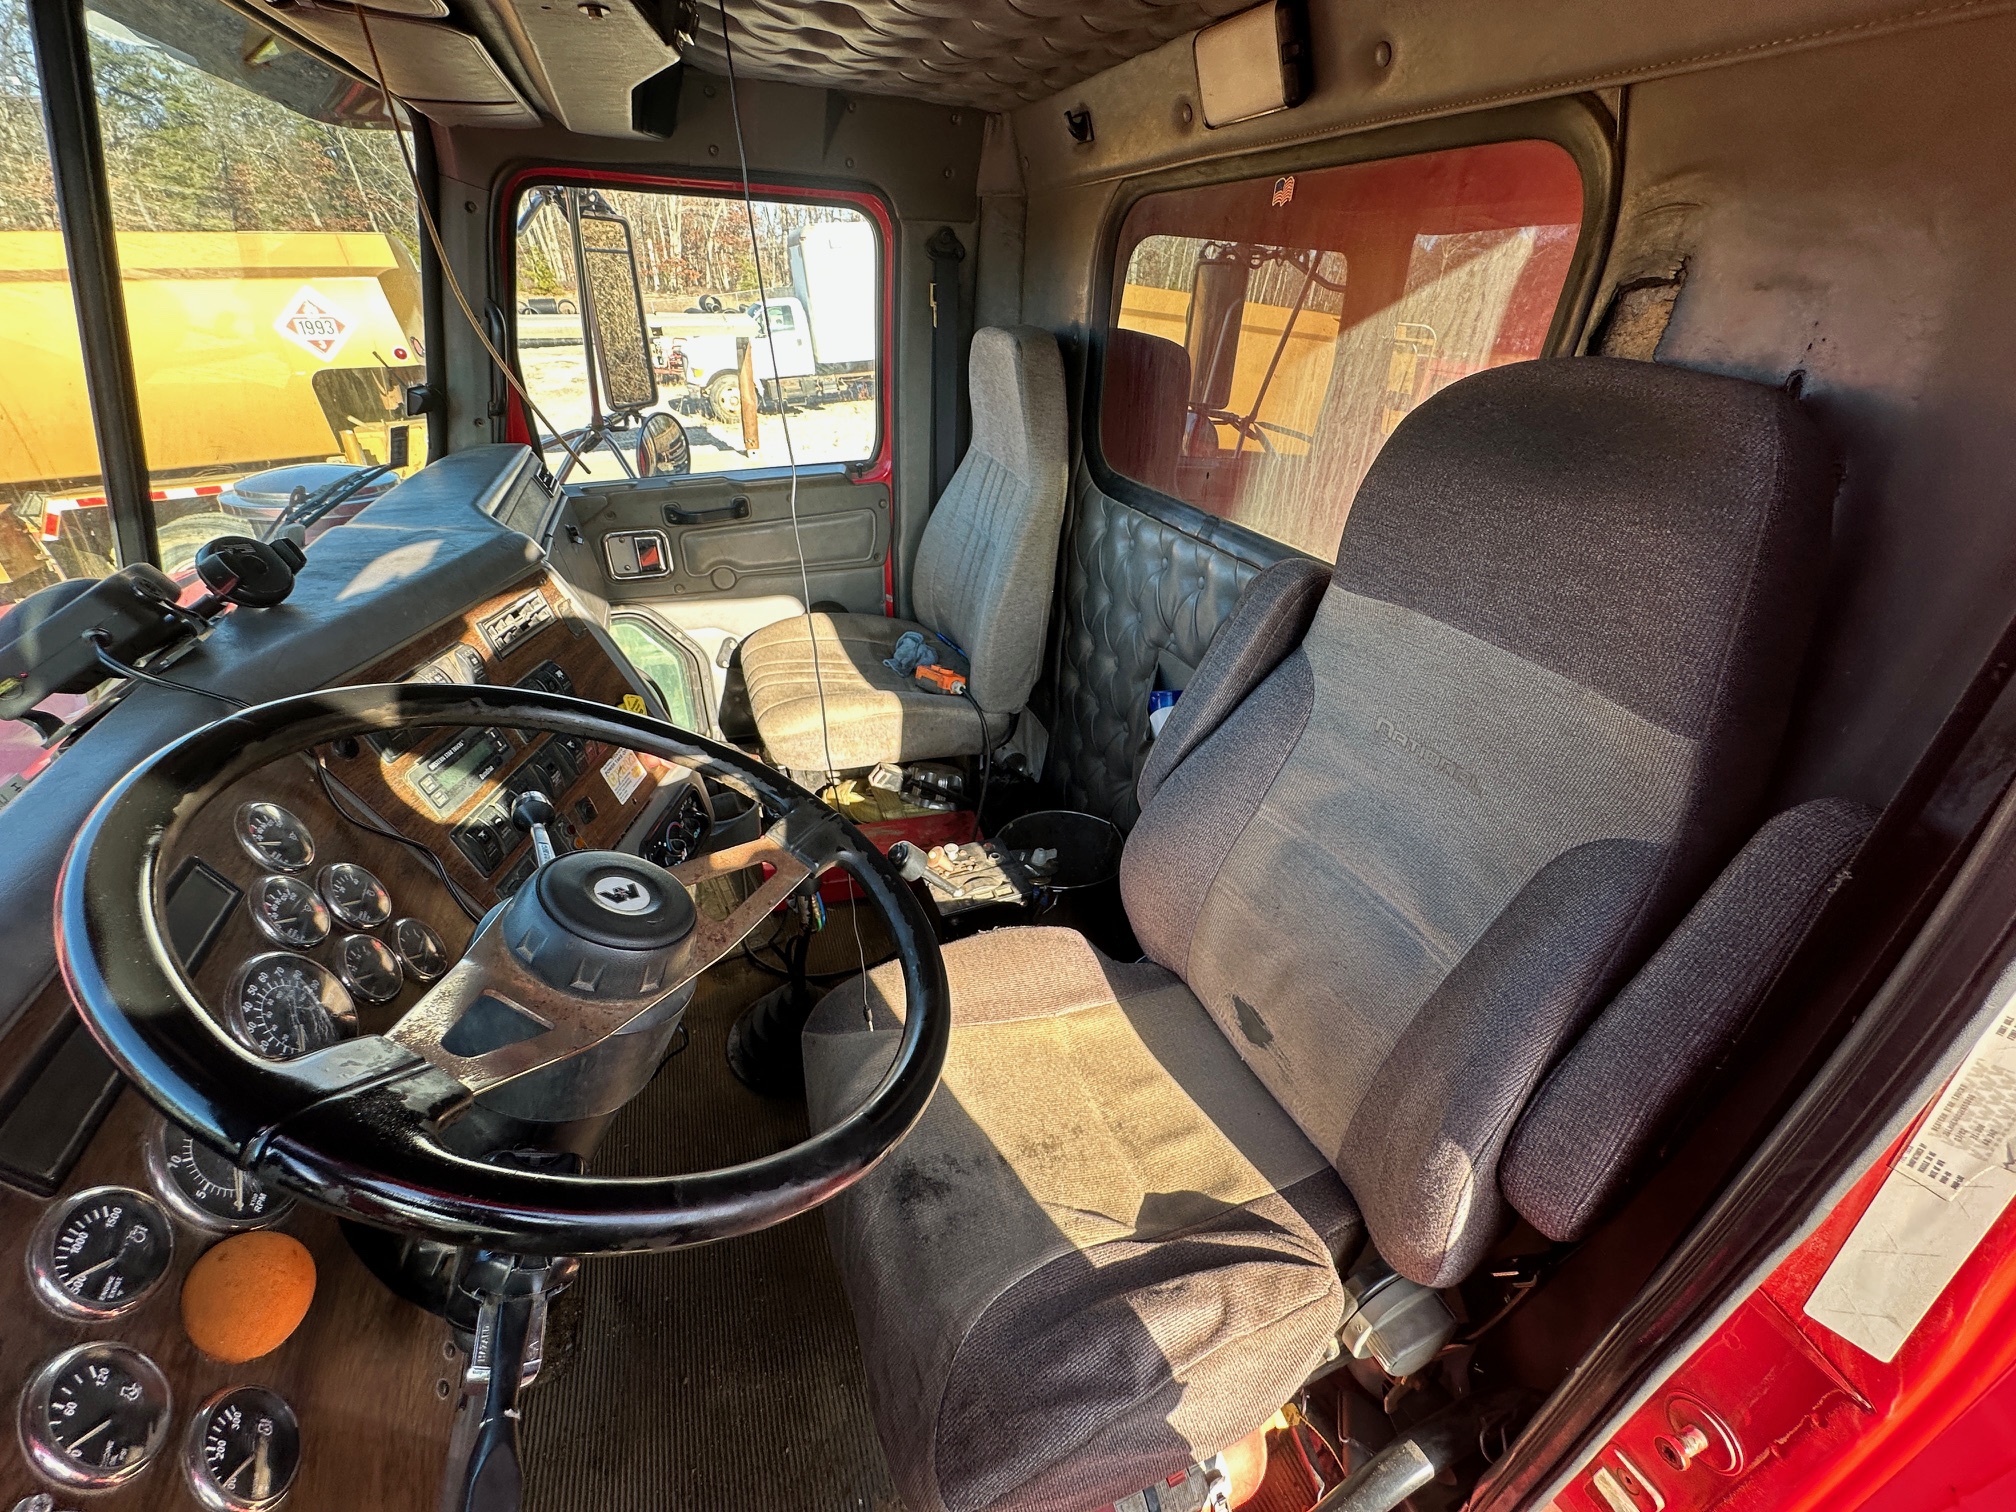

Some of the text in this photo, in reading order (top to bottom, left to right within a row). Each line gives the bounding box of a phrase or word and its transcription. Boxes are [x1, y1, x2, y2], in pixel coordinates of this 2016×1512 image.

[298, 320, 335, 335] 1993
[258, 971, 268, 982] 60
[275, 966, 285, 978] 70
[293, 969, 303, 981] 80
[247, 984, 258, 996] 50
[311, 979, 320, 990] 90
[242, 1001, 253, 1013] 40
[167, 1154, 181, 1169] 10
[195, 1189, 206, 1200] 5
[253, 1192, 268, 1214] RPM
[105, 1207, 122, 1229] 1500
[70, 1231, 89, 1254] 1000
[95, 1367, 110, 1386] 120
[63, 1401, 78, 1417] 60
[231, 1411, 243, 1431] 300
[214, 1439, 227, 1460] 200
